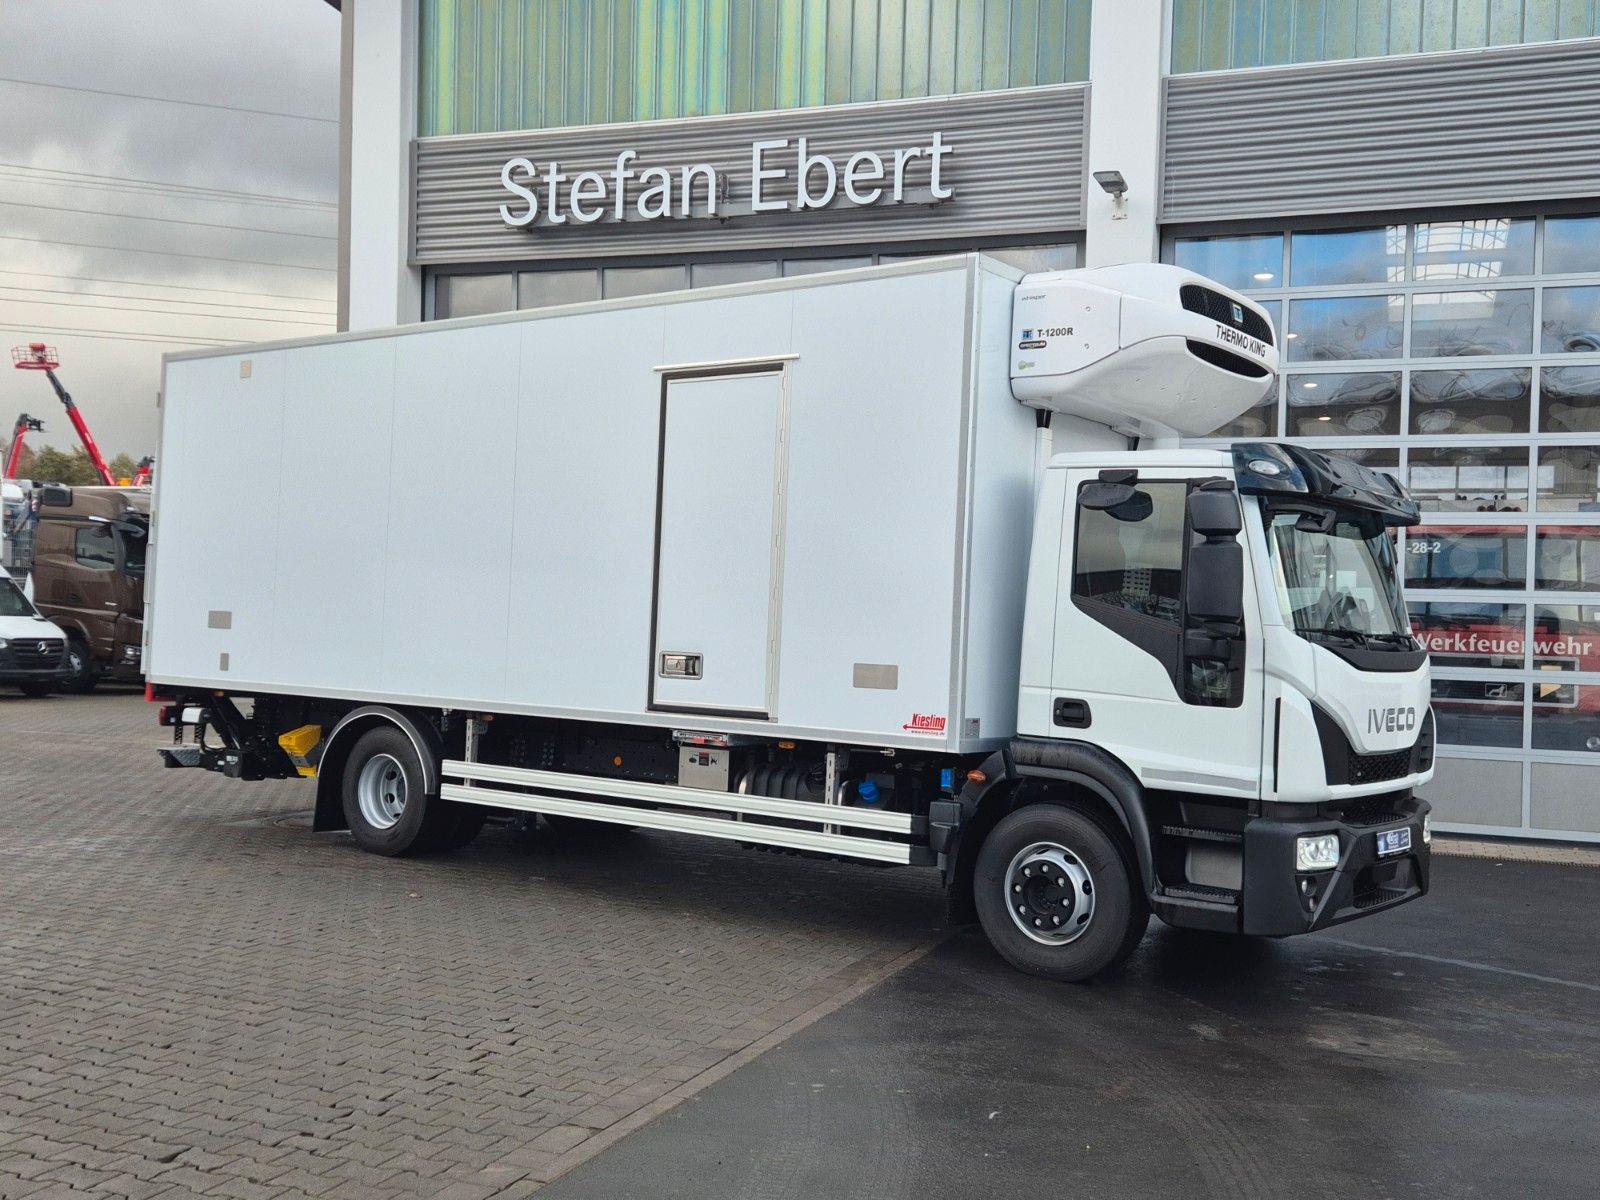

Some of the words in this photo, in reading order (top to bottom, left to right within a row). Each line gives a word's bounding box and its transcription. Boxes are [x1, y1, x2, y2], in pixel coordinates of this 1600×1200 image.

[499, 150, 717, 227] Stefan
[752, 131, 954, 212] Ebert
[1037, 327, 1073, 338] T-1200R
[1216, 324, 1249, 349] THERMO
[1249, 339, 1266, 358] KING
[912, 713, 946, 730] Kiesling
[1368, 707, 1415, 734] IVECO
